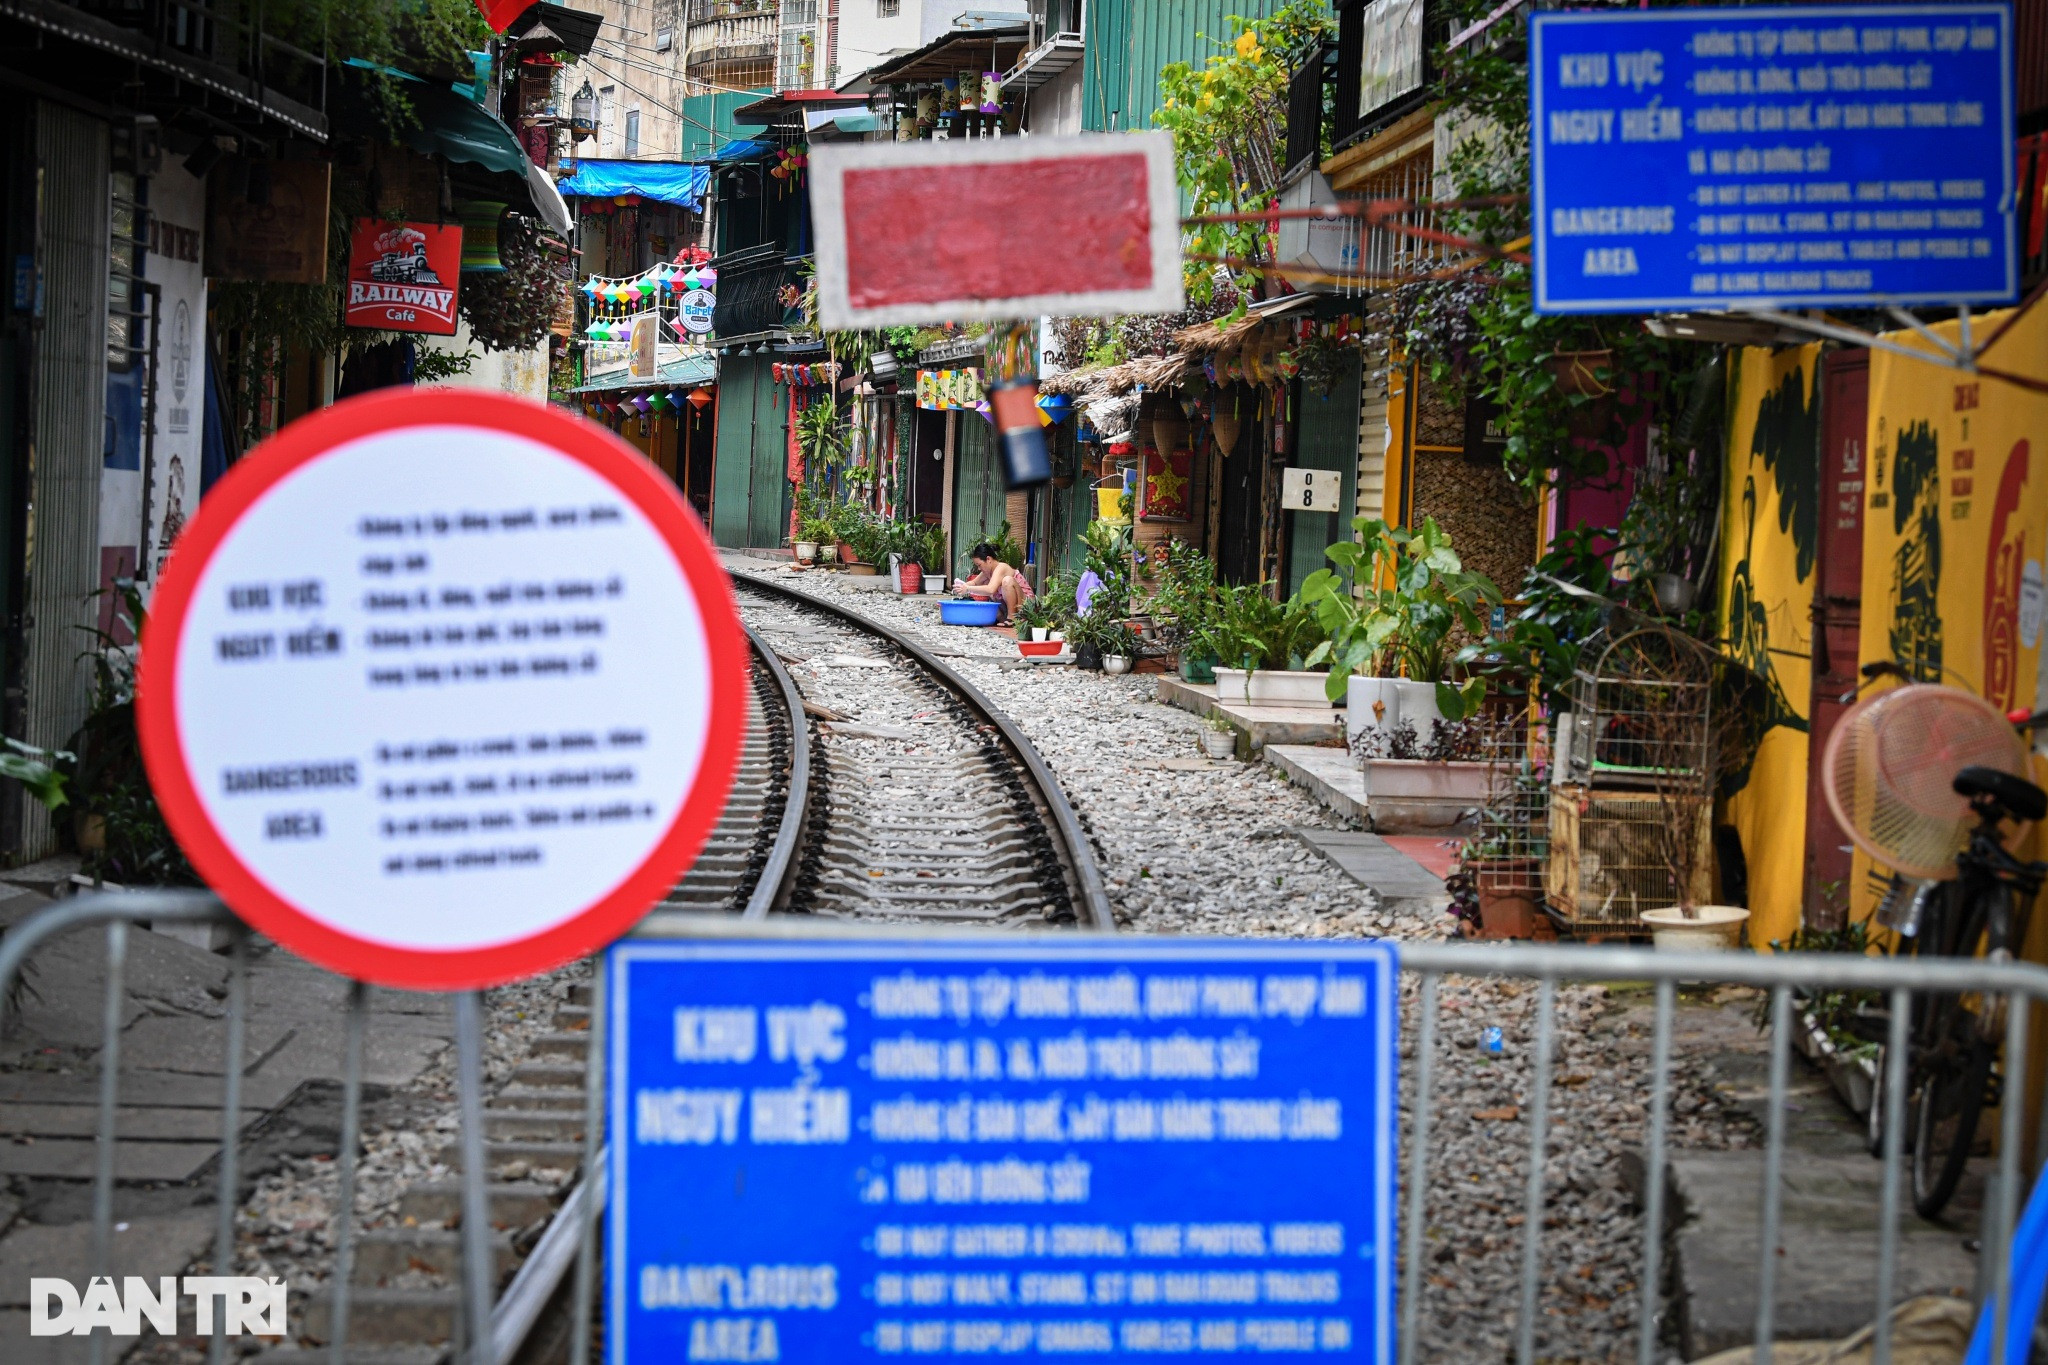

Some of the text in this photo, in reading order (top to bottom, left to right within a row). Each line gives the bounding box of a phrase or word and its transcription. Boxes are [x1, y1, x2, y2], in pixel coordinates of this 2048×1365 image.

[1559, 48, 1664, 94] KHU VỰC
[1550, 108, 1615, 145] NGUY
[1552, 206, 1675, 237] DANGEROUS
[1582, 247, 1640, 277] AREA
[350, 283, 453, 314] RAILWAY
[386, 308, 416, 322] Café
[1303, 489, 1313, 507] 8
[223, 761, 358, 794] DANGEROUS
[673, 1000, 847, 1069] KHU VỰC
[635, 1087, 743, 1145] NGUY
[687, 1316, 782, 1364] AREA
